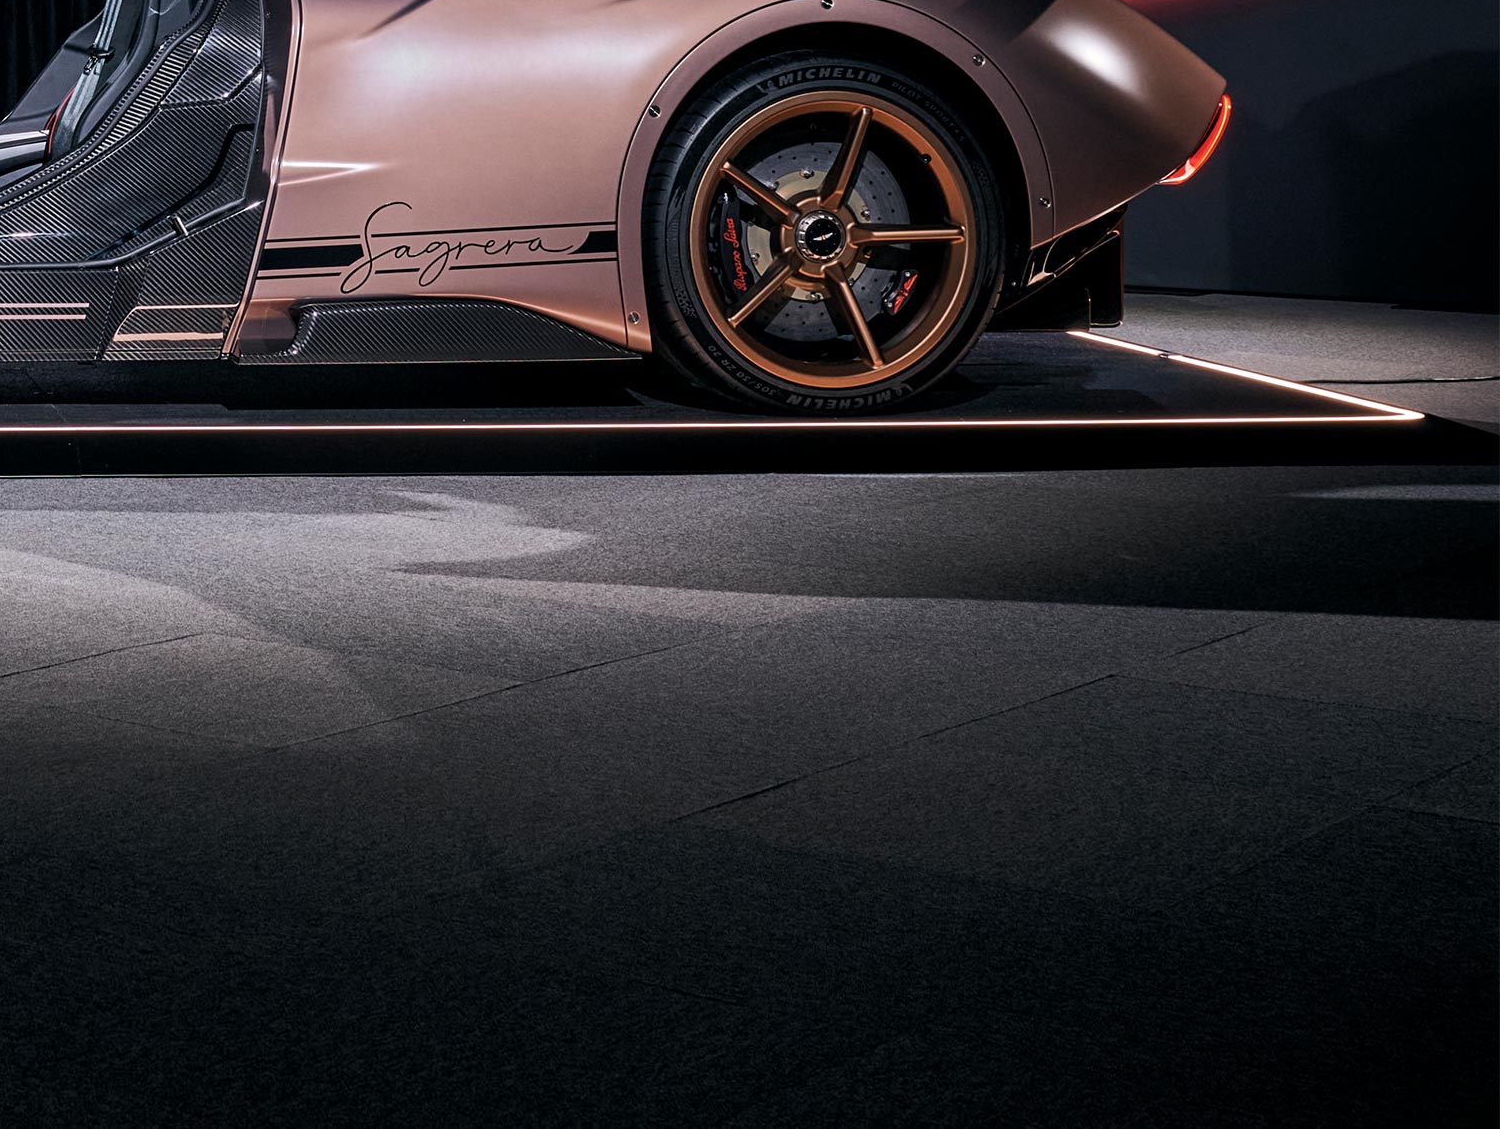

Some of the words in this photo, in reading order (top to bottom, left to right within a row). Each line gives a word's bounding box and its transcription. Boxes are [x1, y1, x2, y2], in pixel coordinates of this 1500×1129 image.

[778, 66, 882, 87] MICHELIN
[891, 81, 922, 101] PILOT
[340, 201, 574, 294] Sagrera
[707, 345, 722, 358] 20
[721, 358, 736, 373] ZR
[786, 391, 892, 410] MICHELIN
